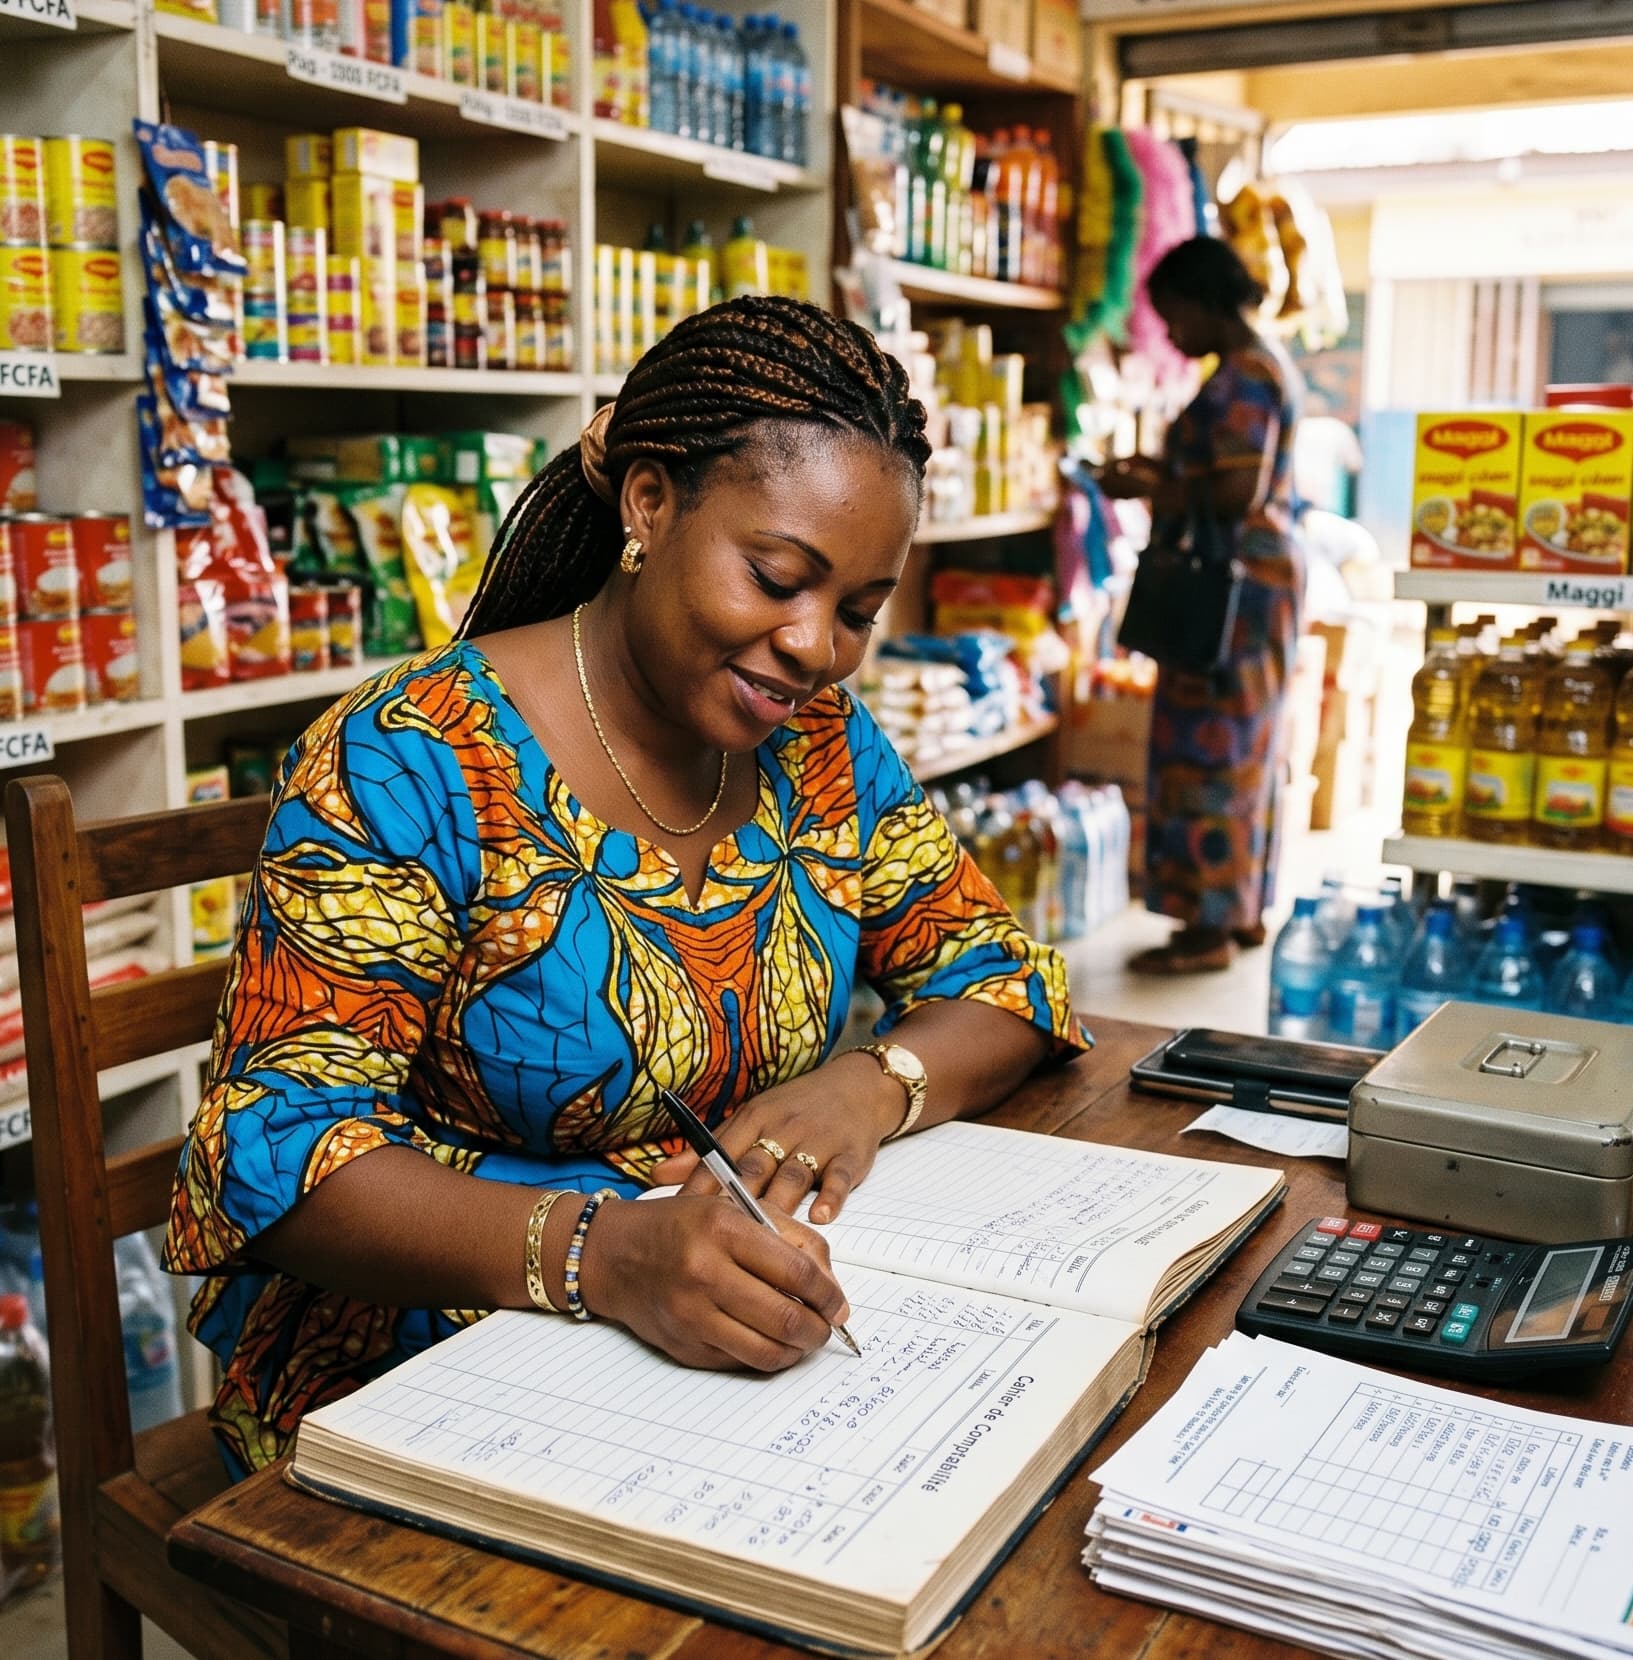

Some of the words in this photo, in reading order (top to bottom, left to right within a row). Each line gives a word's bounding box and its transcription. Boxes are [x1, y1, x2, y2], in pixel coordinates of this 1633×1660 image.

[0, 363, 54, 388] FCFA
[1547, 580, 1625, 608] Maggi
[997, 1375, 1035, 1408] Cahier
[983, 1408, 1005, 1422] de
[920, 1423, 992, 1494] Comptabilité
